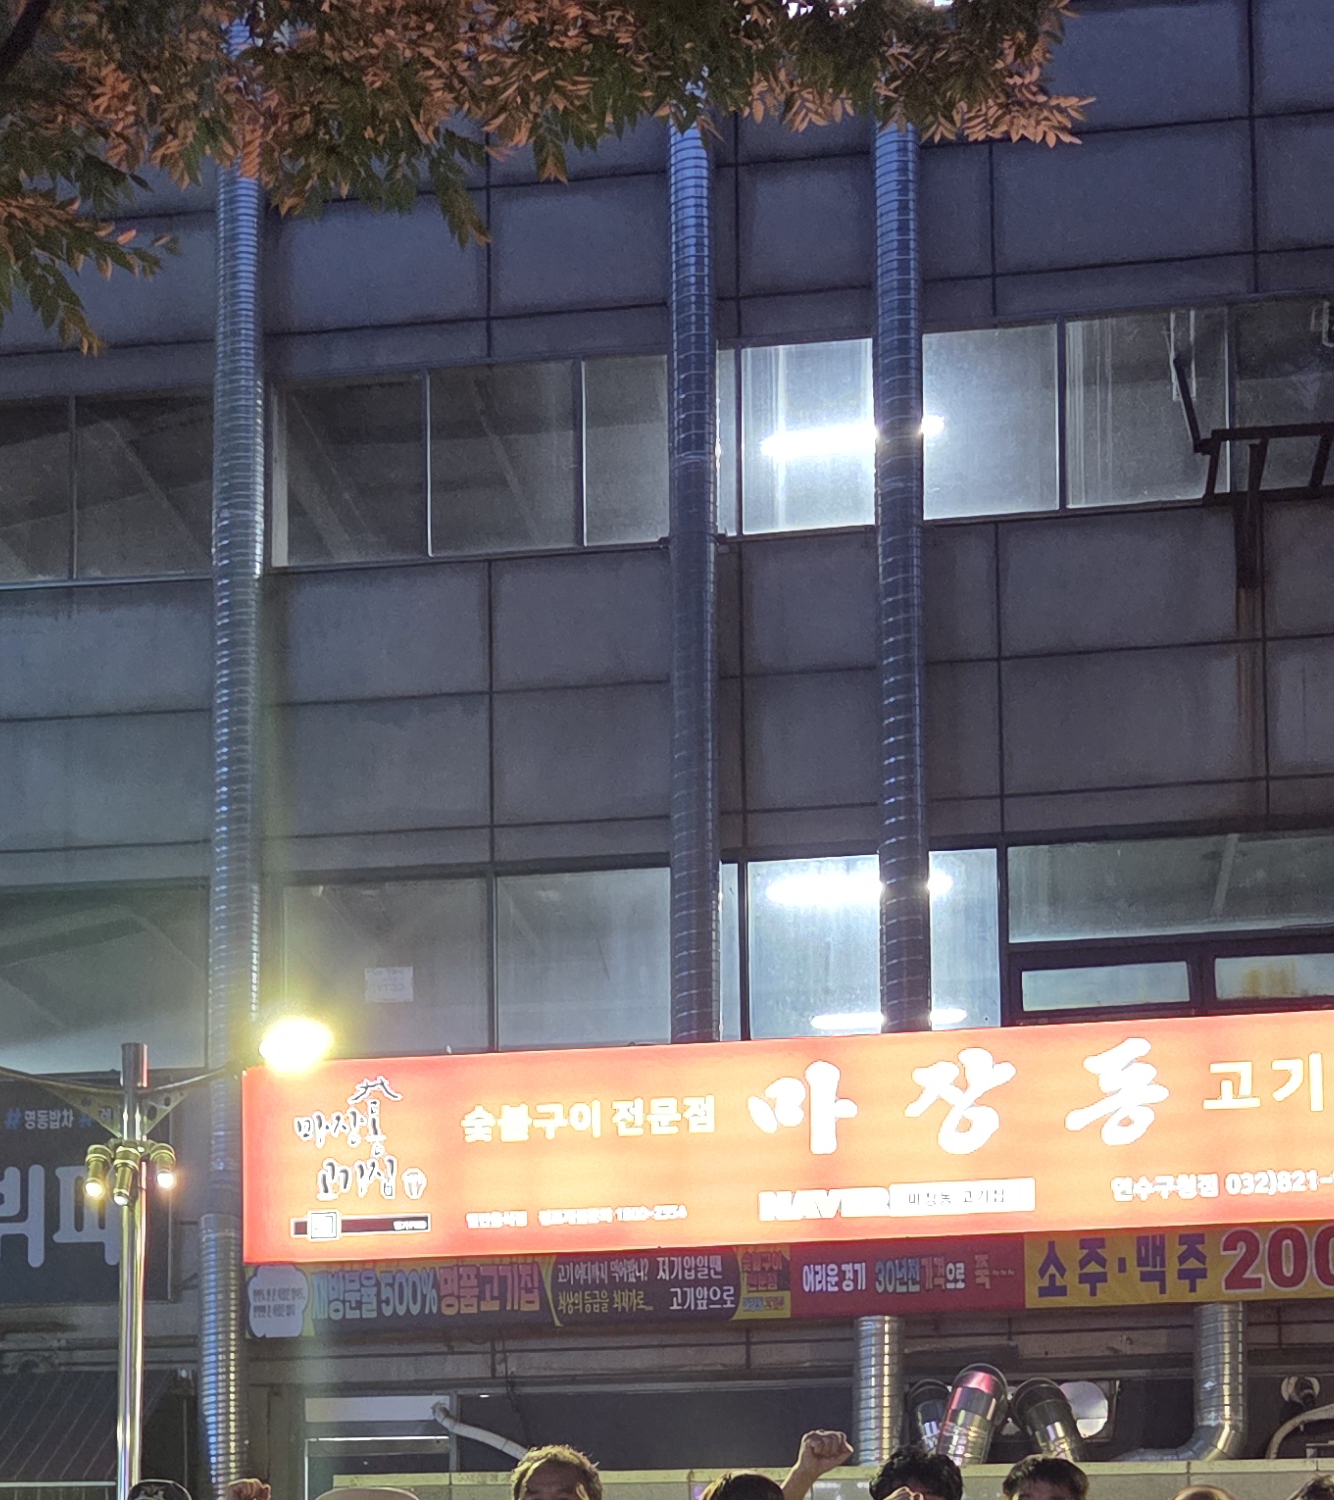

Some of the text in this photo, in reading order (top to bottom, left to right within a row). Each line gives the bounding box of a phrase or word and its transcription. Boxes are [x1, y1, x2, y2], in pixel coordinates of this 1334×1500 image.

[611, 1094, 716, 1137] 전문점
[747, 1037, 1170, 1156] 마장동
[380, 1266, 439, 1317] 500%
[669, 1285, 736, 1311] 고기앞으로
[802, 1263, 839, 1293] 어려운
[841, 1262, 866, 1292] 경기
